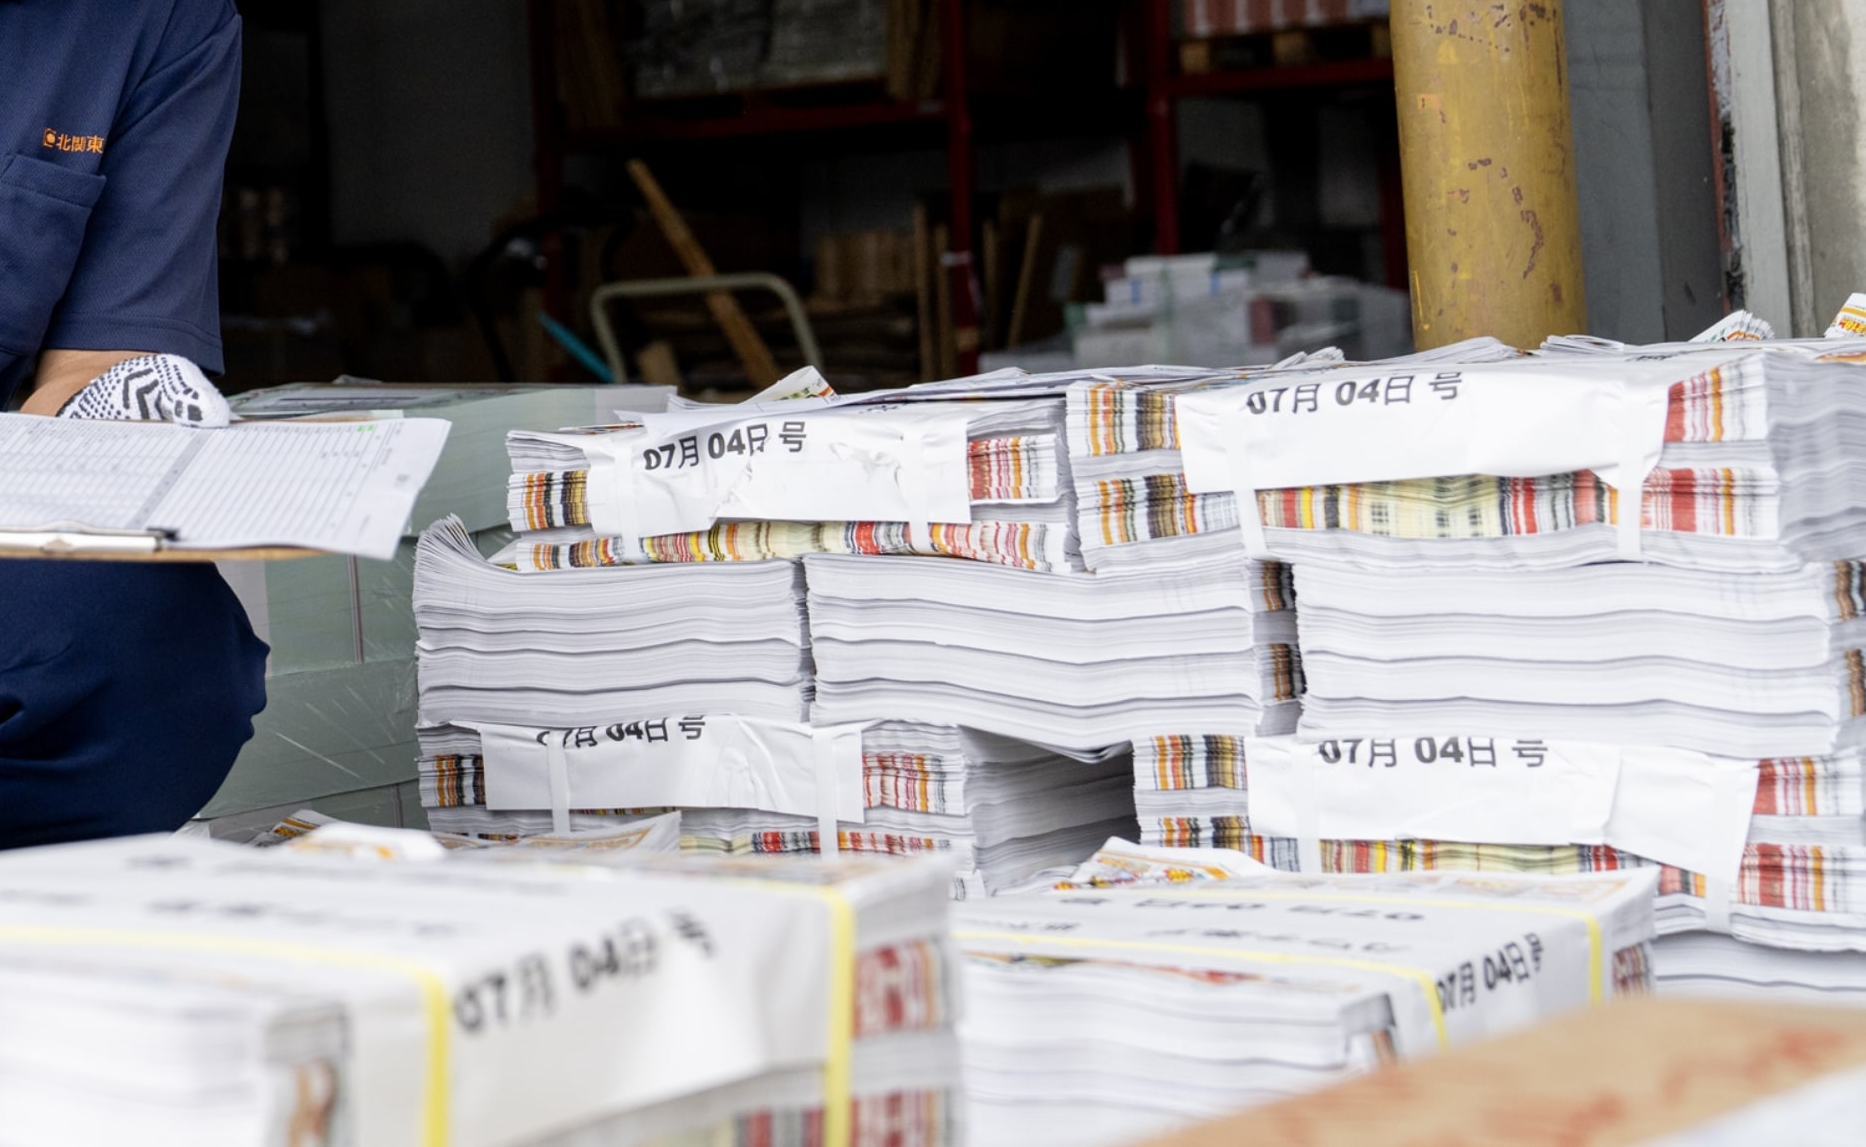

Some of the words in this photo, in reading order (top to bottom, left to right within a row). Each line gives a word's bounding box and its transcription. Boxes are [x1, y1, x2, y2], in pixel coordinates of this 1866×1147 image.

[1246, 383, 1321, 415] 07月
[1334, 375, 1415, 406] 04日
[642, 435, 700, 470] 07月
[778, 421, 807, 452] 号
[1318, 738, 1397, 768] 07月
